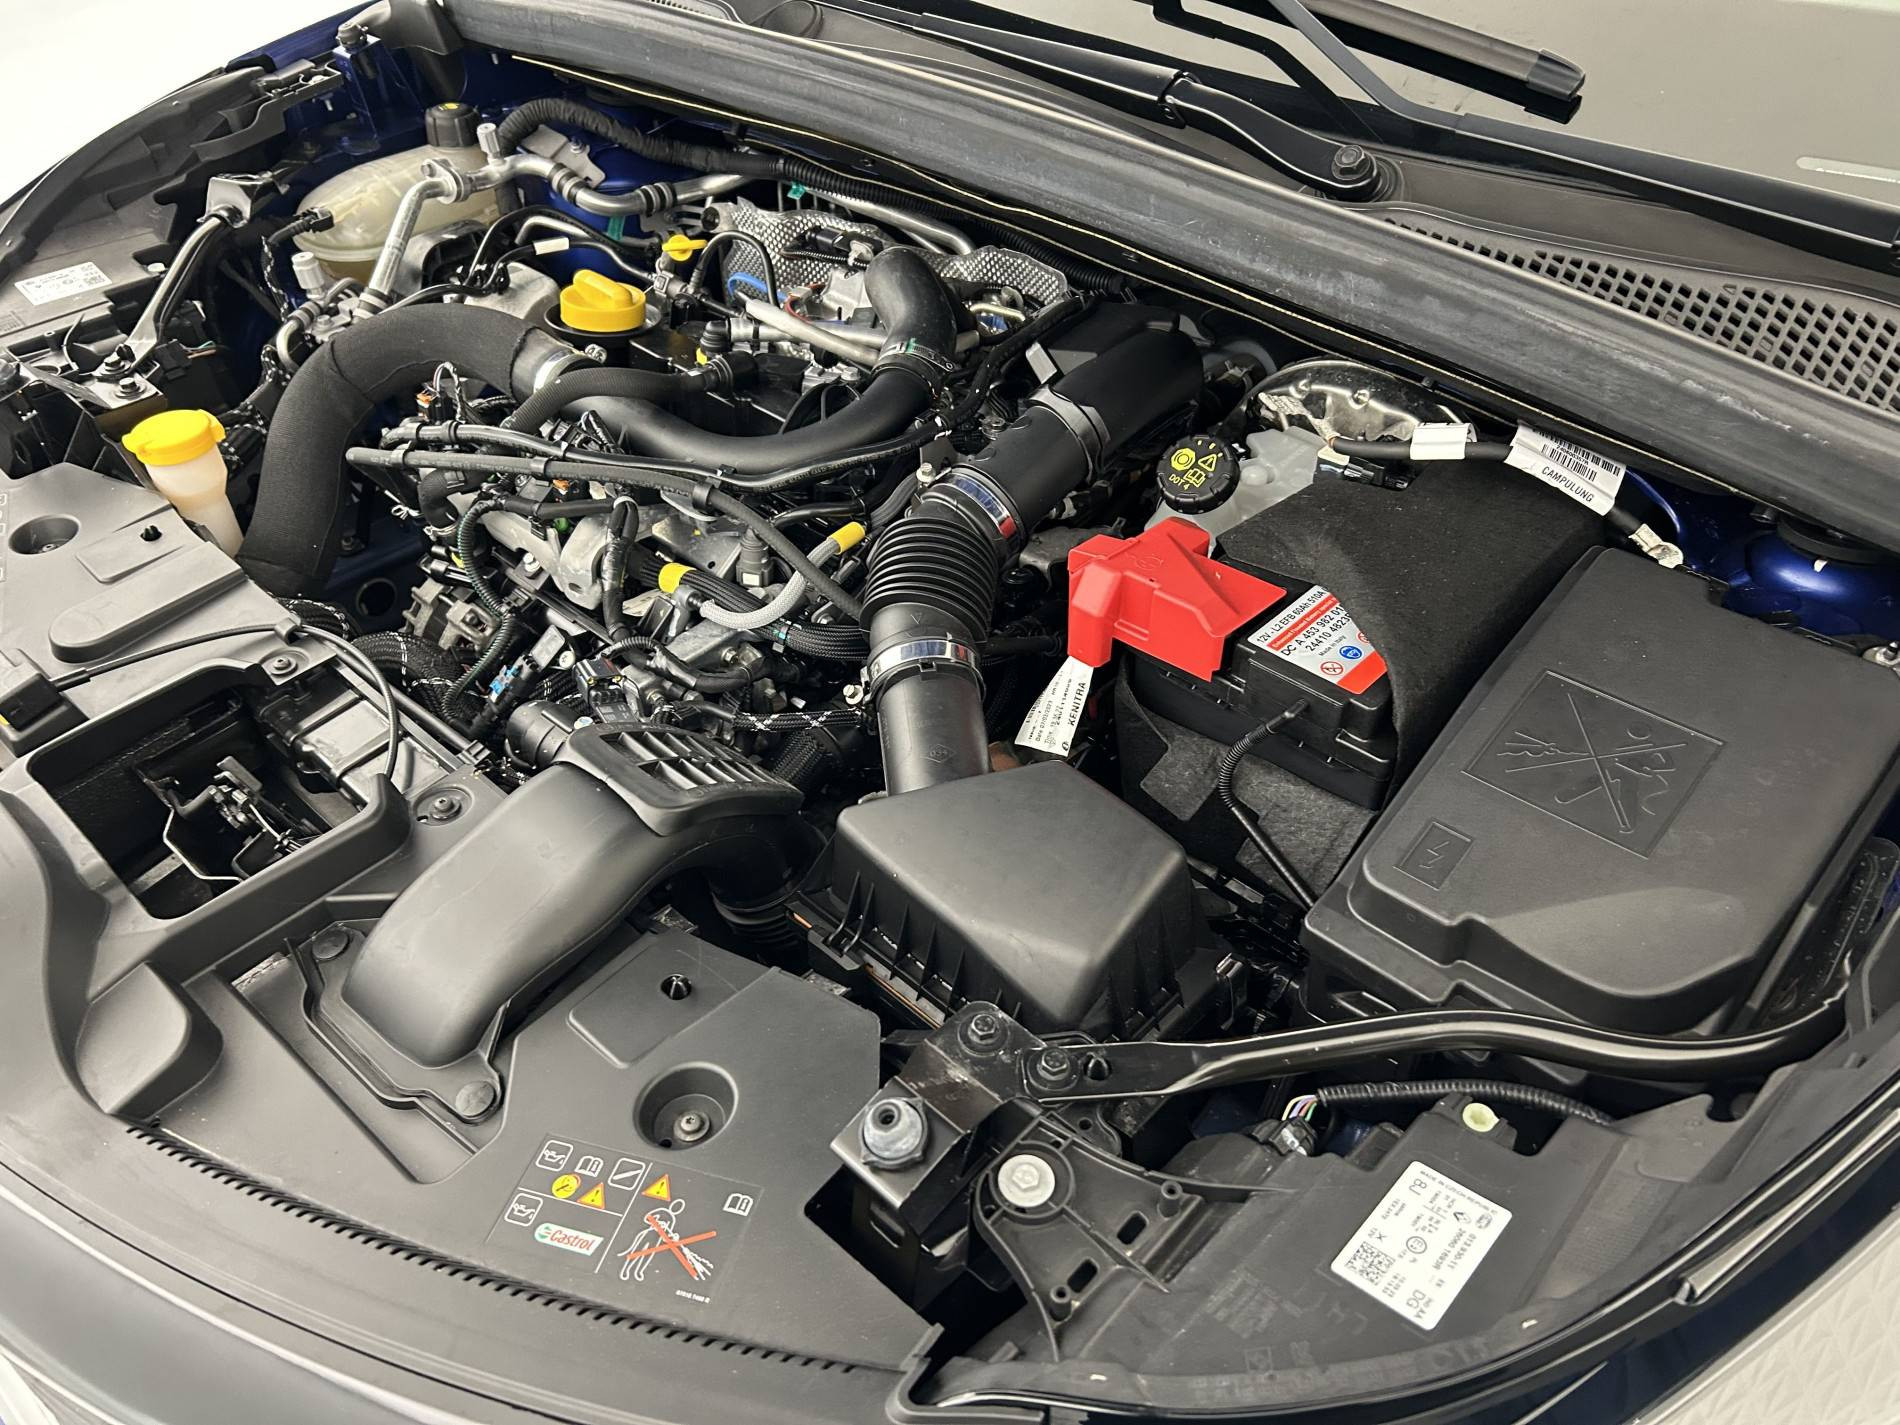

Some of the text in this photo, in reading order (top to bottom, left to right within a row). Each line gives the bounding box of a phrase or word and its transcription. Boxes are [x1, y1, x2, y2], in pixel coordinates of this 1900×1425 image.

[1169, 474, 1185, 486] DOT
[1542, 466, 1594, 502] CAMPULUNG
[1257, 632, 1271, 643] 12V
[1279, 613, 1296, 625] EFB
[1308, 591, 1325, 603] 510A
[1280, 645, 1296, 655] DC
[1302, 626, 1320, 639] 453
[1316, 614, 1335, 628] 982
[1305, 632, 1331, 651] 24410
[1067, 682, 1086, 726] KENITRA
[550, 1229, 595, 1251] Castrol
